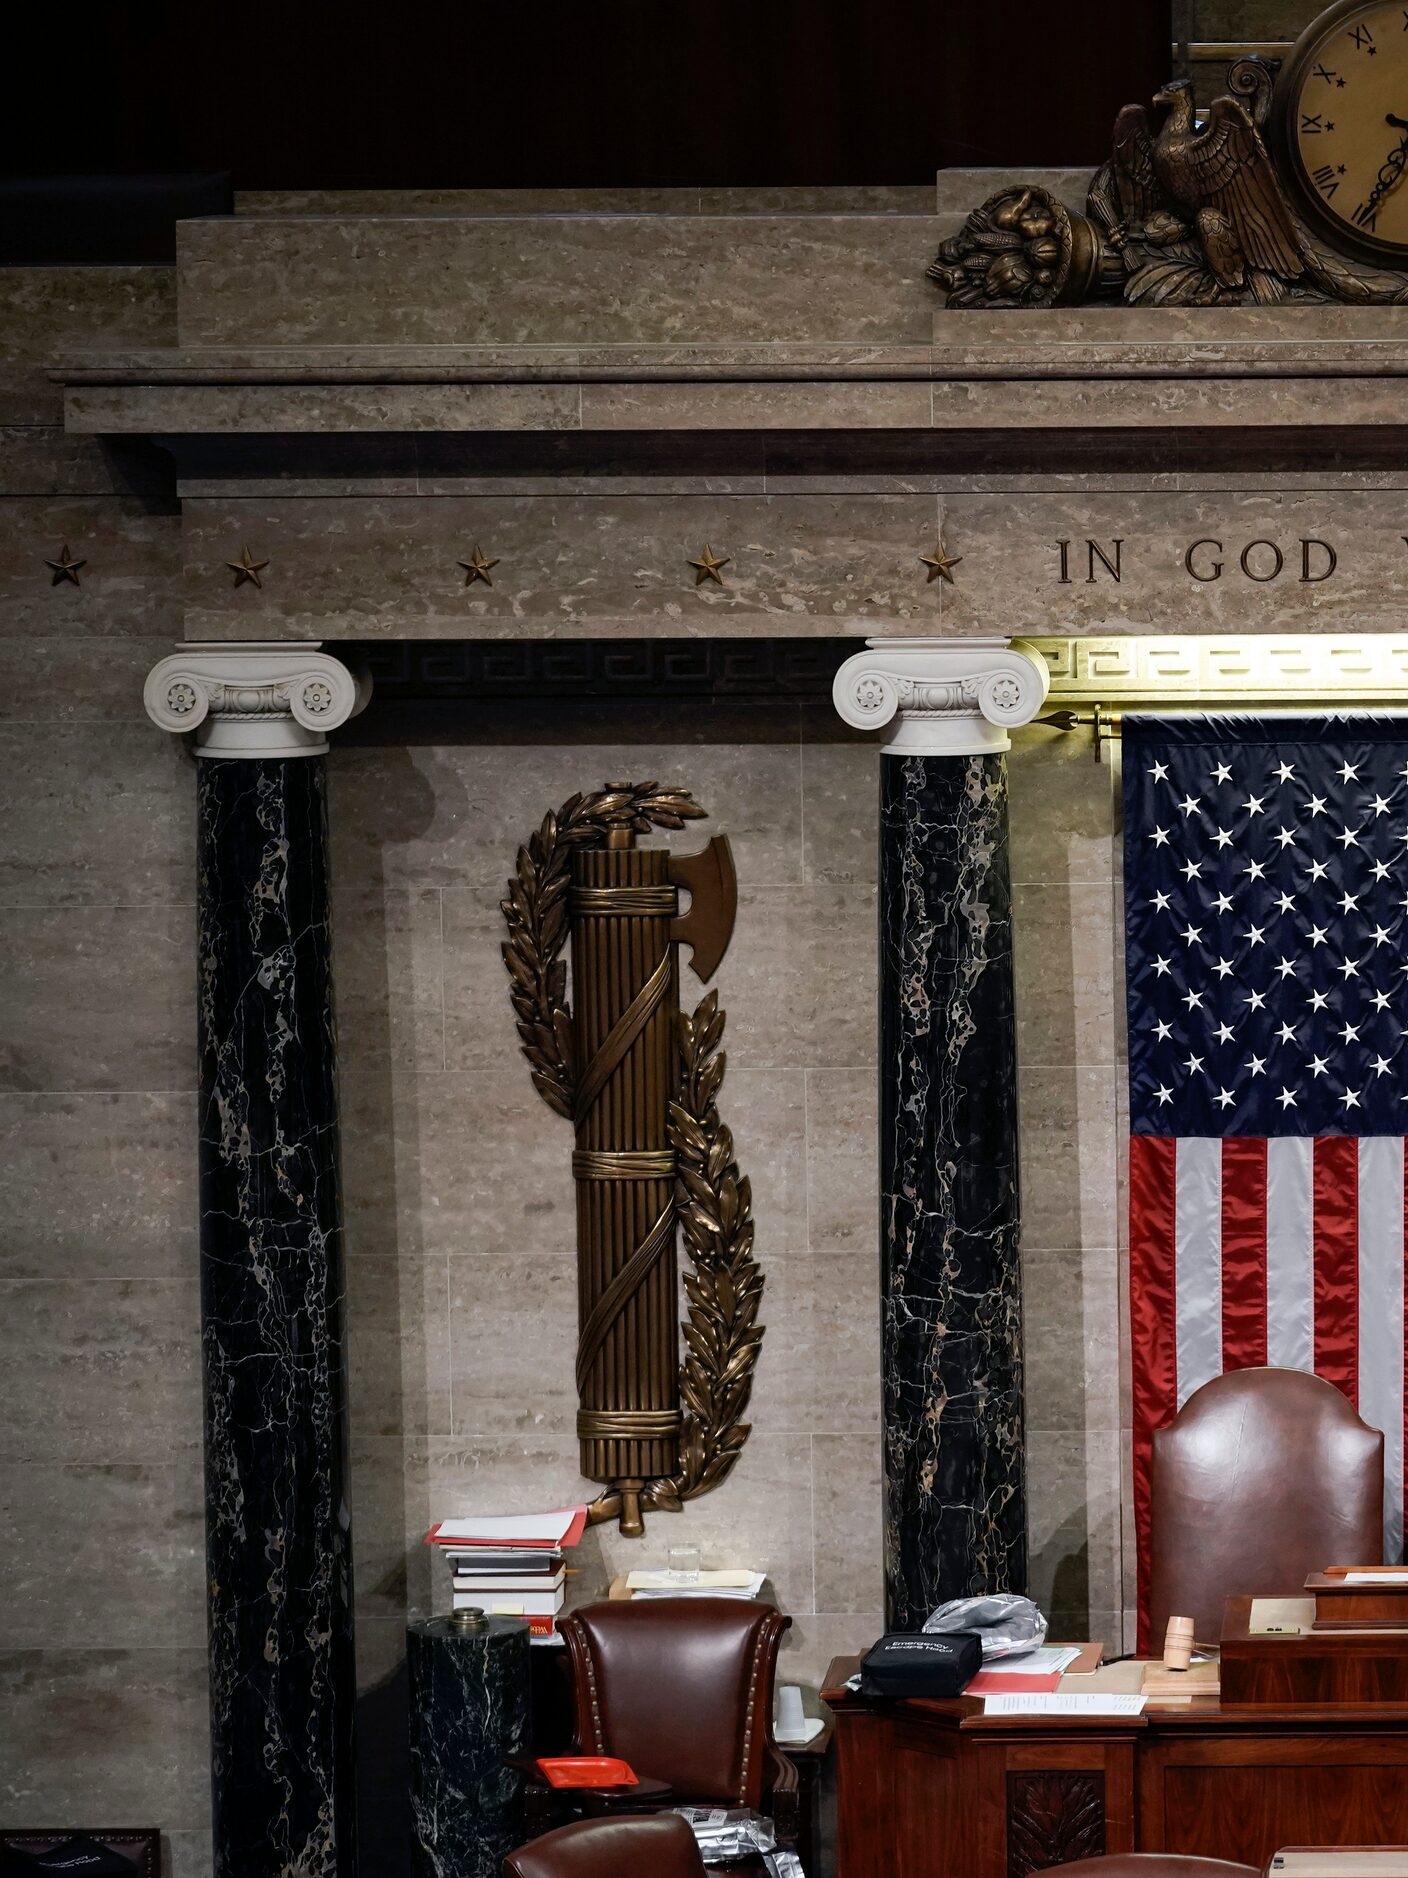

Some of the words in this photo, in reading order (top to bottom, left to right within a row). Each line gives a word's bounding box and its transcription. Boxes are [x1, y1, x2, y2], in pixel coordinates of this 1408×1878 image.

[1346, 23, 1373, 50] XI
[1312, 63, 1337, 85] X
[1301, 113, 1322, 133] IX
[1312, 164, 1340, 200] VIII
[1055, 538, 1125, 584] IN
[1184, 538, 1338, 583] GOD
[892, 1641, 949, 1650] Emergency
[925, 1645, 954, 1653] Hood
